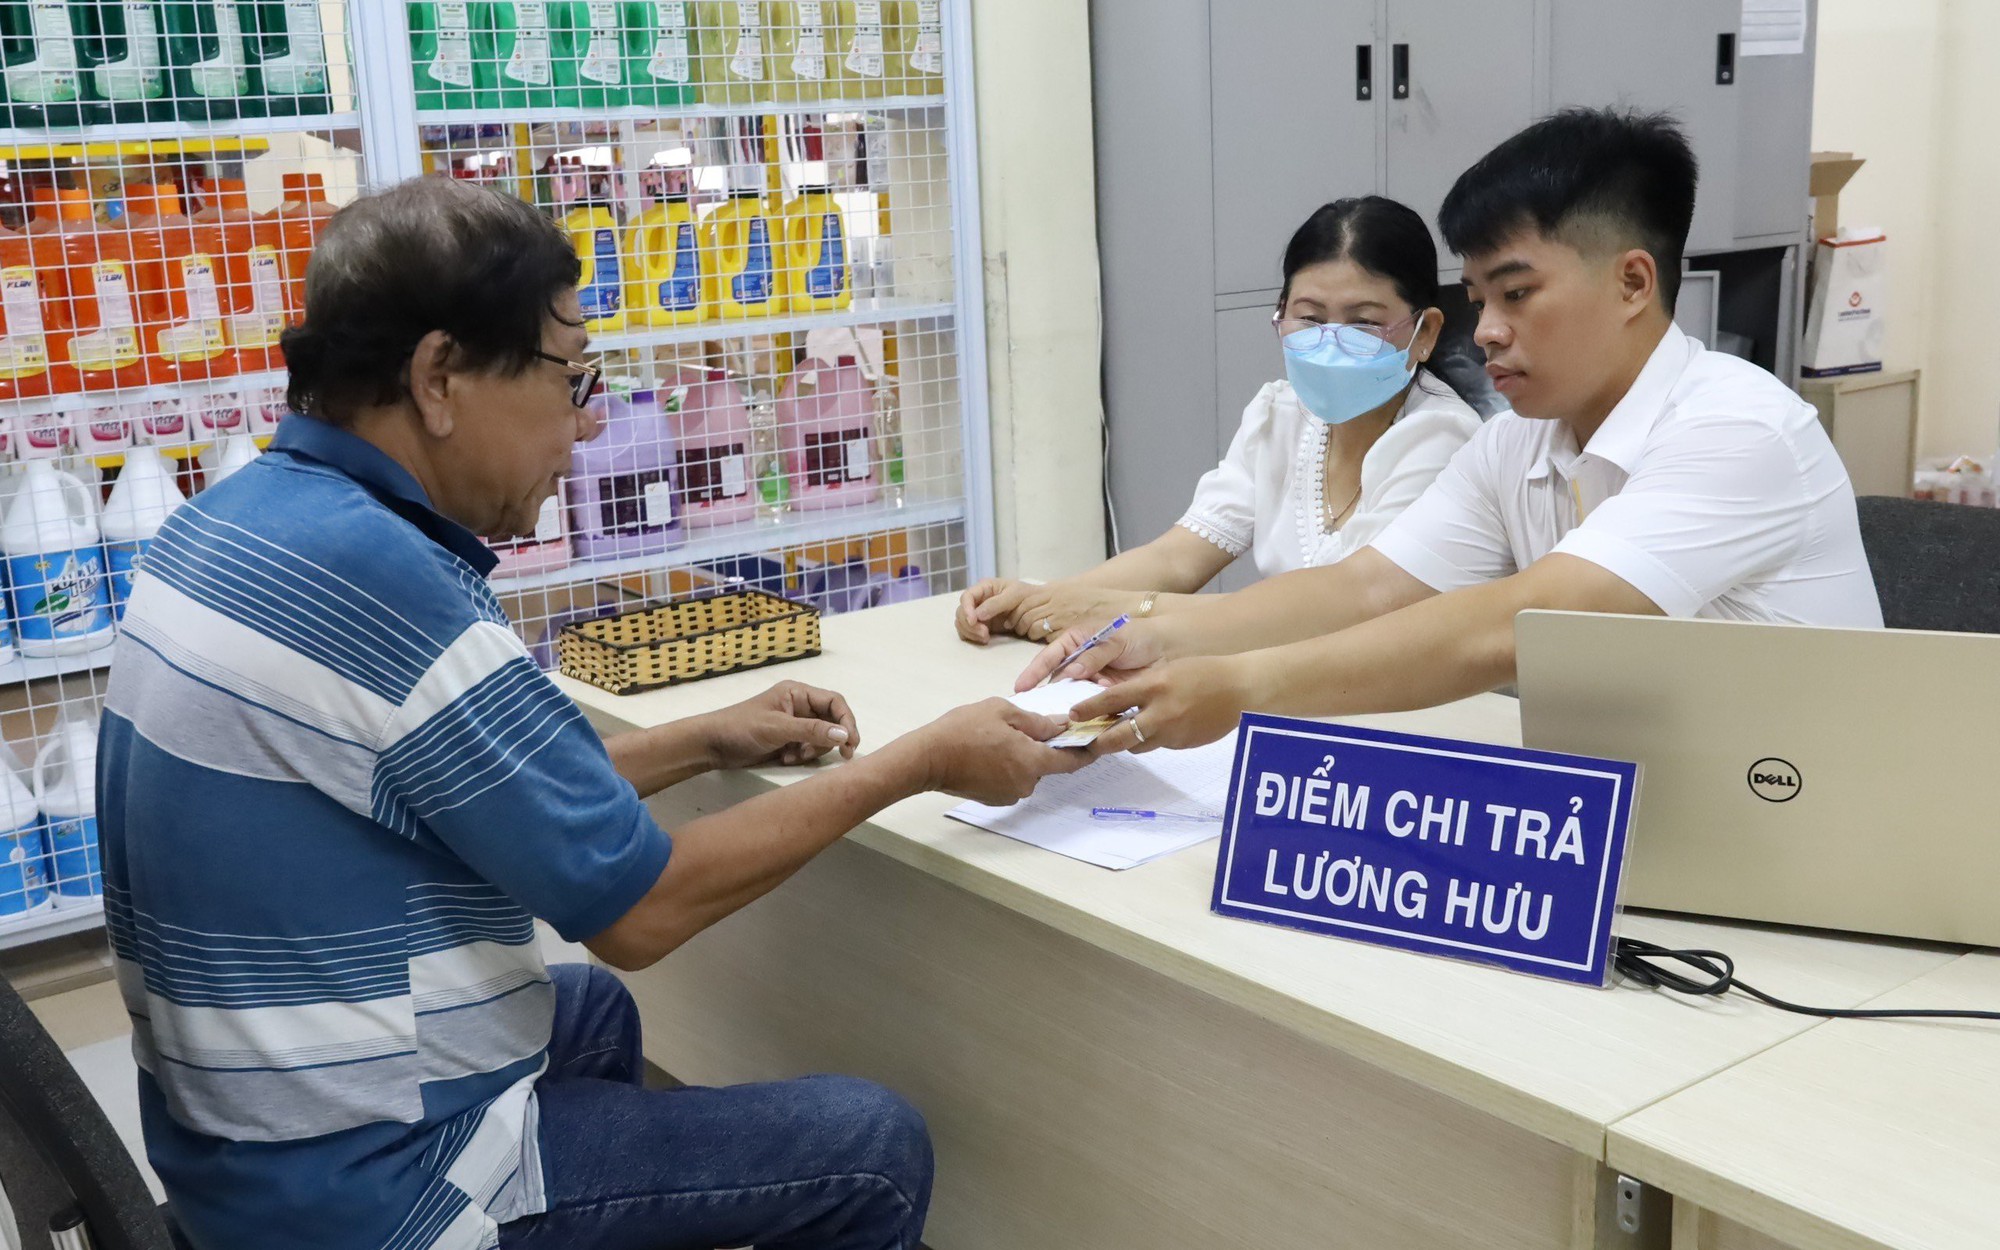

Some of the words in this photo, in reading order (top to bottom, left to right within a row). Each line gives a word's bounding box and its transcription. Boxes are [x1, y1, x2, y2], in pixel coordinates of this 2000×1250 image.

[1255, 754, 1371, 831] ĐIỂM
[1384, 789, 1470, 846] CHI
[1485, 795, 1586, 866] TRẢ
[1753, 773, 1797, 787] DELL
[1263, 848, 1429, 920] LƯƠNG
[1444, 878, 1553, 941] HƯU
